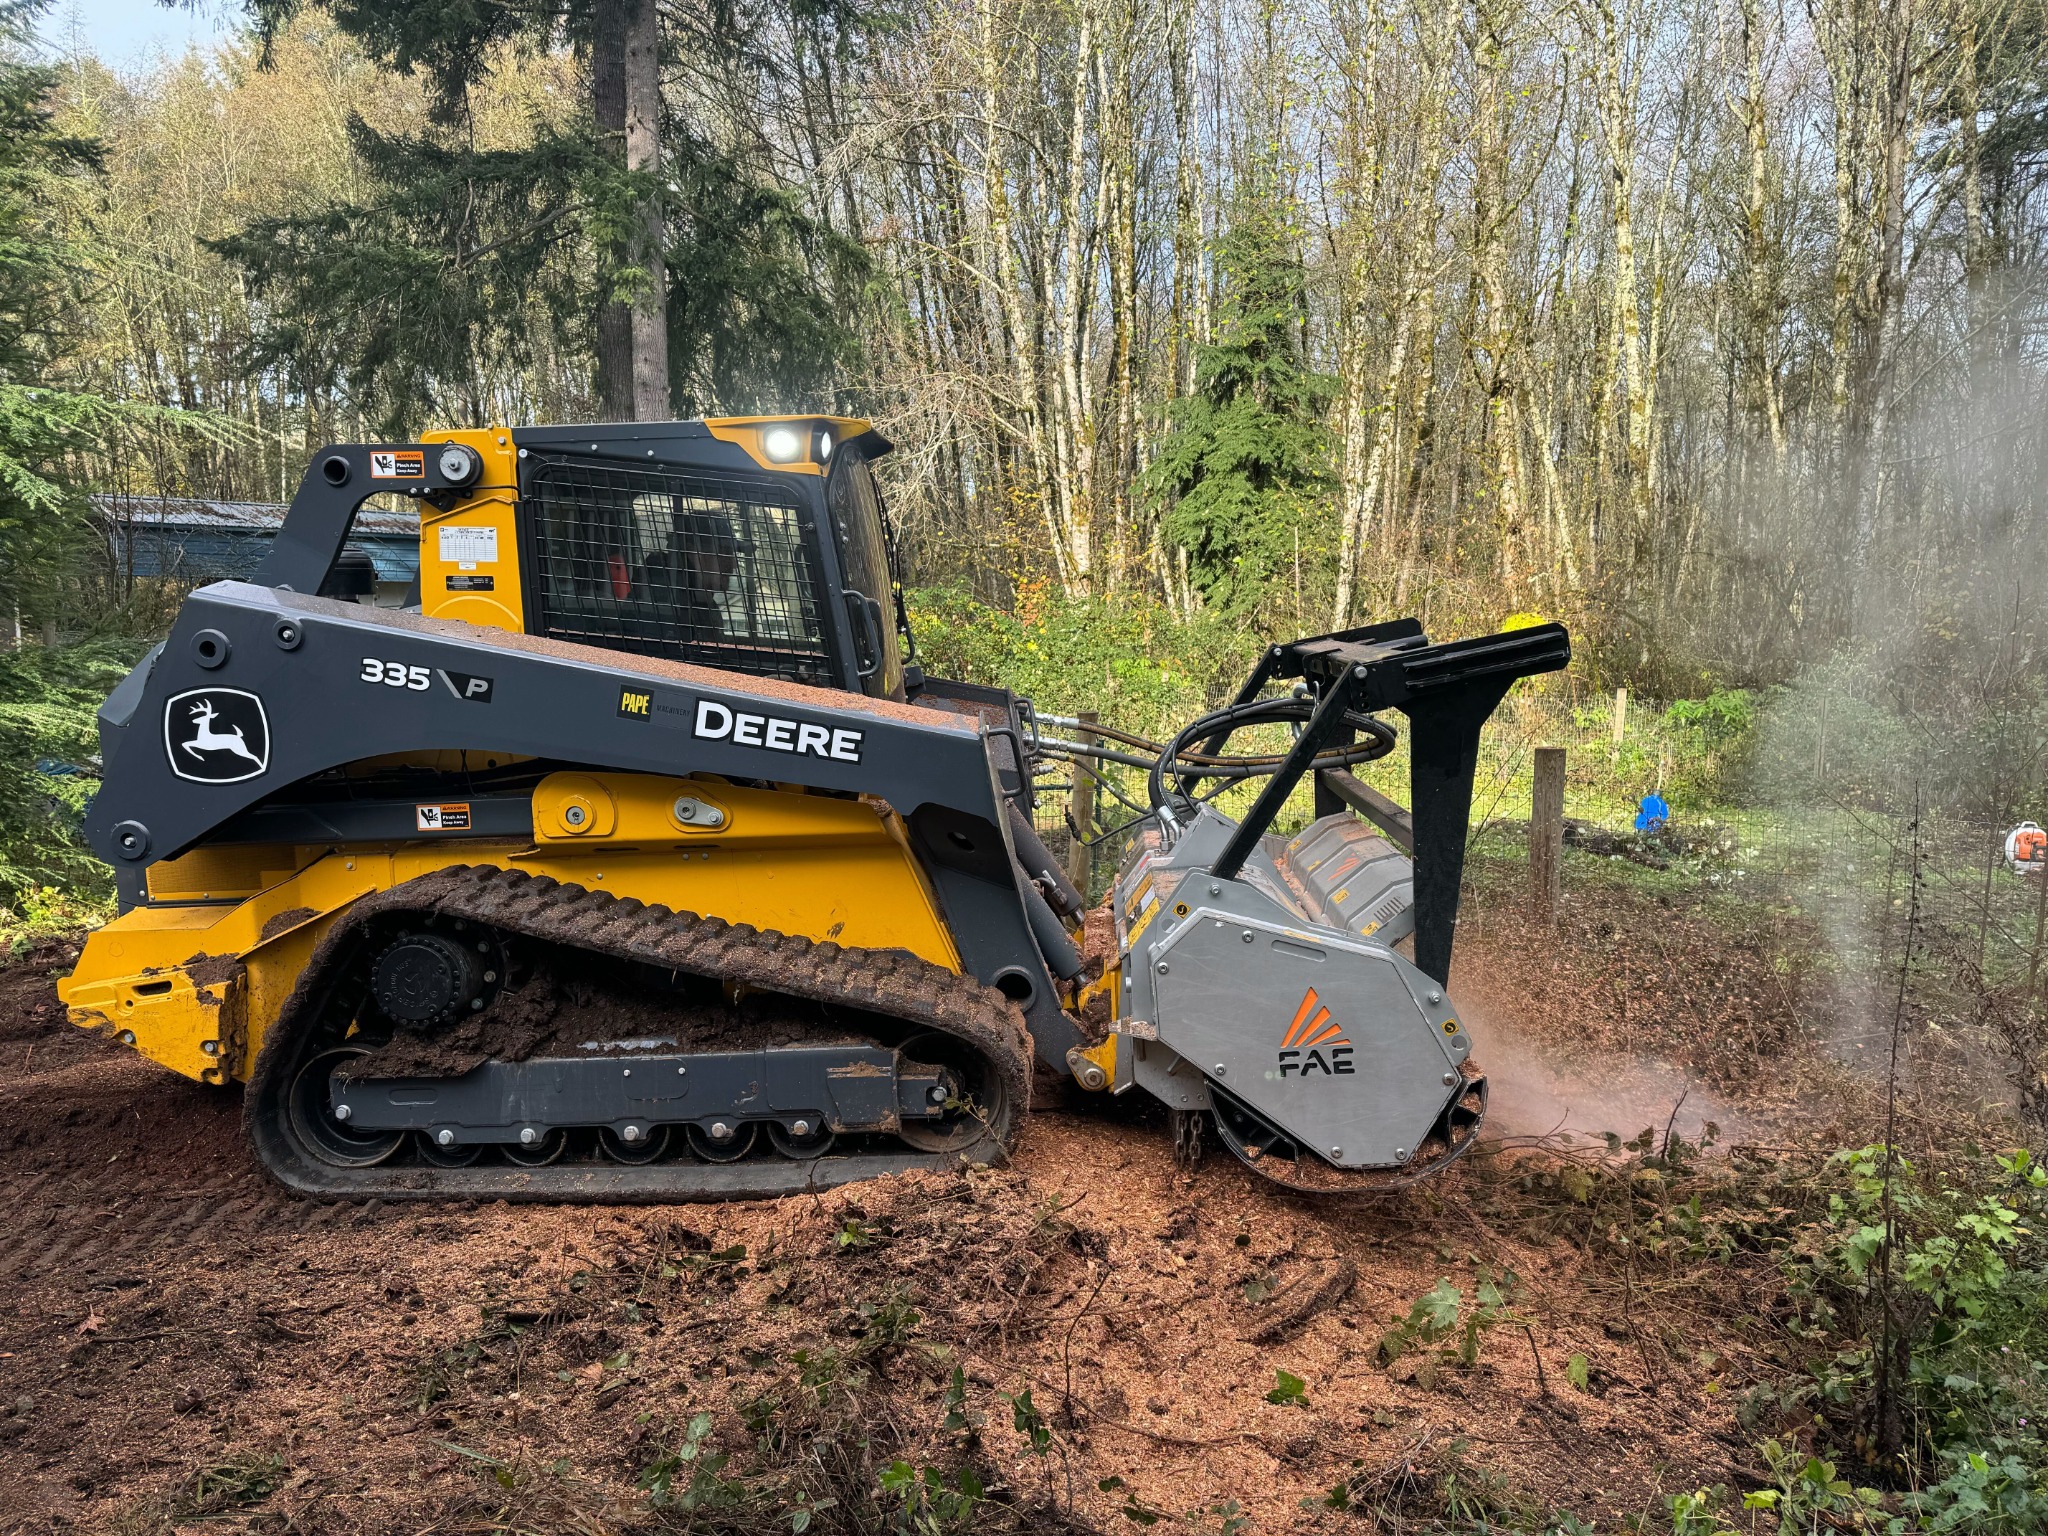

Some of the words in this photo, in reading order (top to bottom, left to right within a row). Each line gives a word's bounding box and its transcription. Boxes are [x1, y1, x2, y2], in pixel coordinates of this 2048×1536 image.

[360, 658, 430, 691] 335
[656, 704, 691, 717] MACHINERY
[694, 700, 862, 762] DEERE
[1279, 1047, 1356, 1078] FAE
